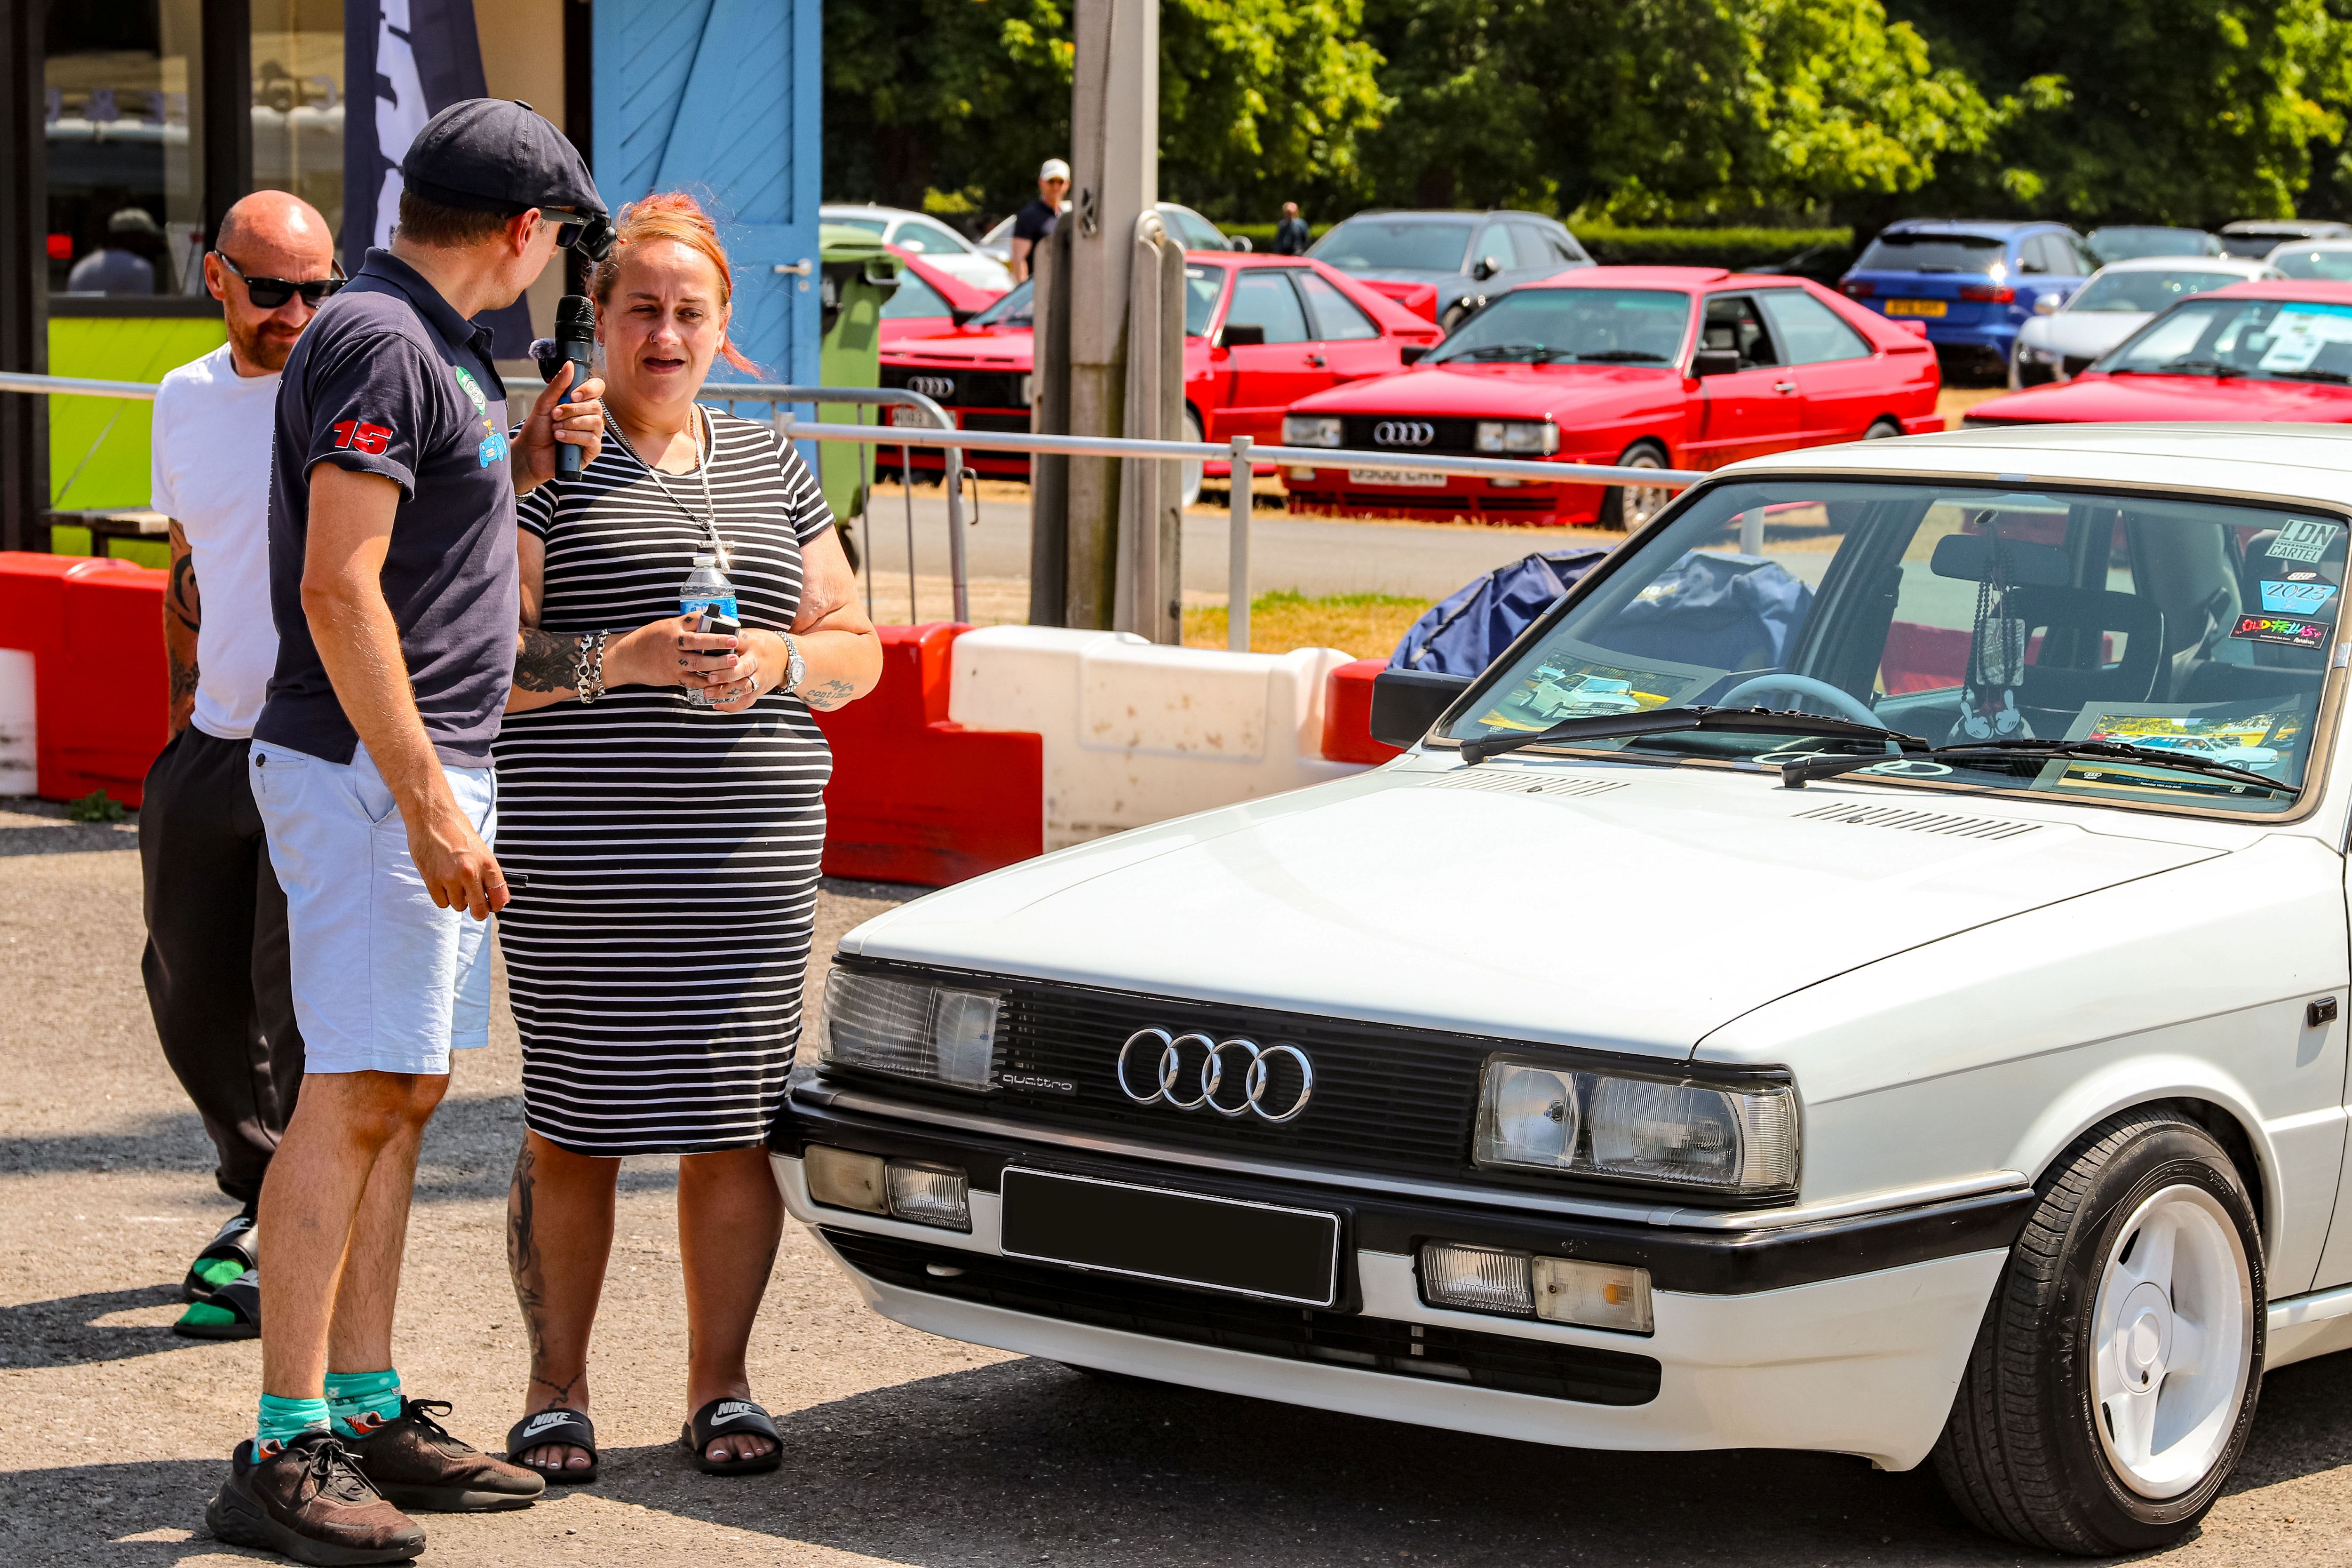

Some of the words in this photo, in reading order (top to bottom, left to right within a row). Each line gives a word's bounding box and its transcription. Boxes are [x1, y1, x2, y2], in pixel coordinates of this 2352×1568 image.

[334, 420, 393, 455] 15
[2279, 521, 2336, 546] LDN
[2270, 546, 2318, 561] CARTEL
[2265, 584, 2329, 601] 2023
[1002, 1074, 1073, 1091] quattro
[717, 1402, 753, 1416] NIKE
[531, 1412, 571, 1427] NIKE
